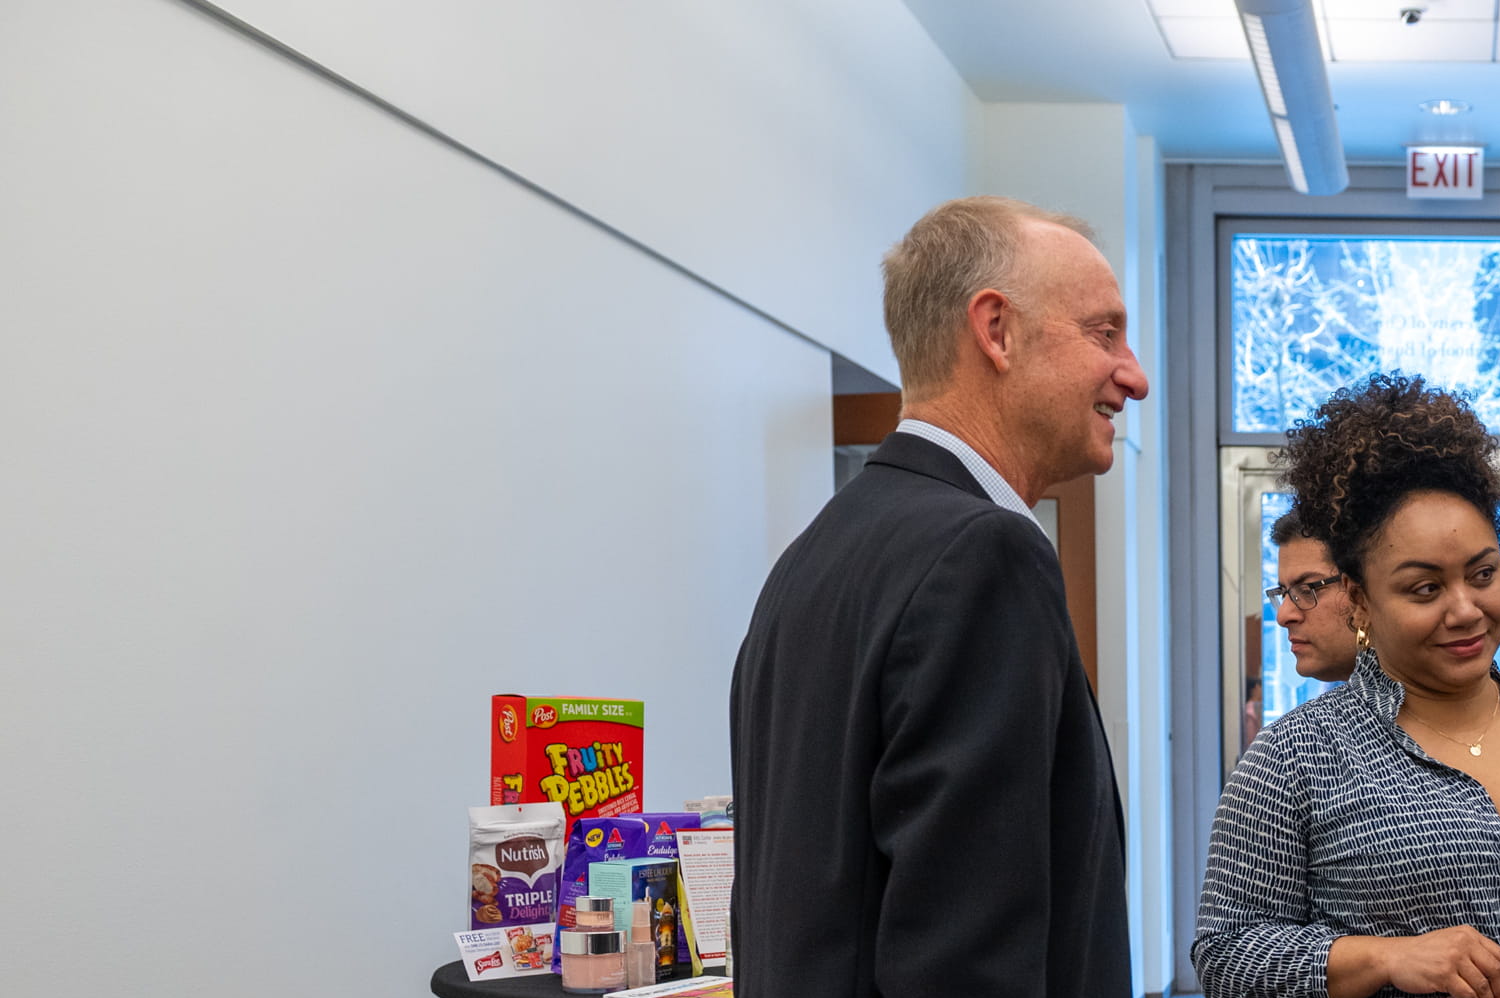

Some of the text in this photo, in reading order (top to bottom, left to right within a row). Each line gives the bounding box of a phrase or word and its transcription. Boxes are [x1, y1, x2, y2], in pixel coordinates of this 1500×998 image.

[1411, 152, 1479, 187] EXIT
[534, 707, 554, 724] Post
[562, 703, 625, 716] FAMILY SIZE
[541, 762, 634, 817] PEBBLES
[587, 832, 602, 843] NEW
[501, 845, 546, 863] Nutrish
[505, 890, 553, 907] TRIPLE
[459, 933, 486, 944] FREE
